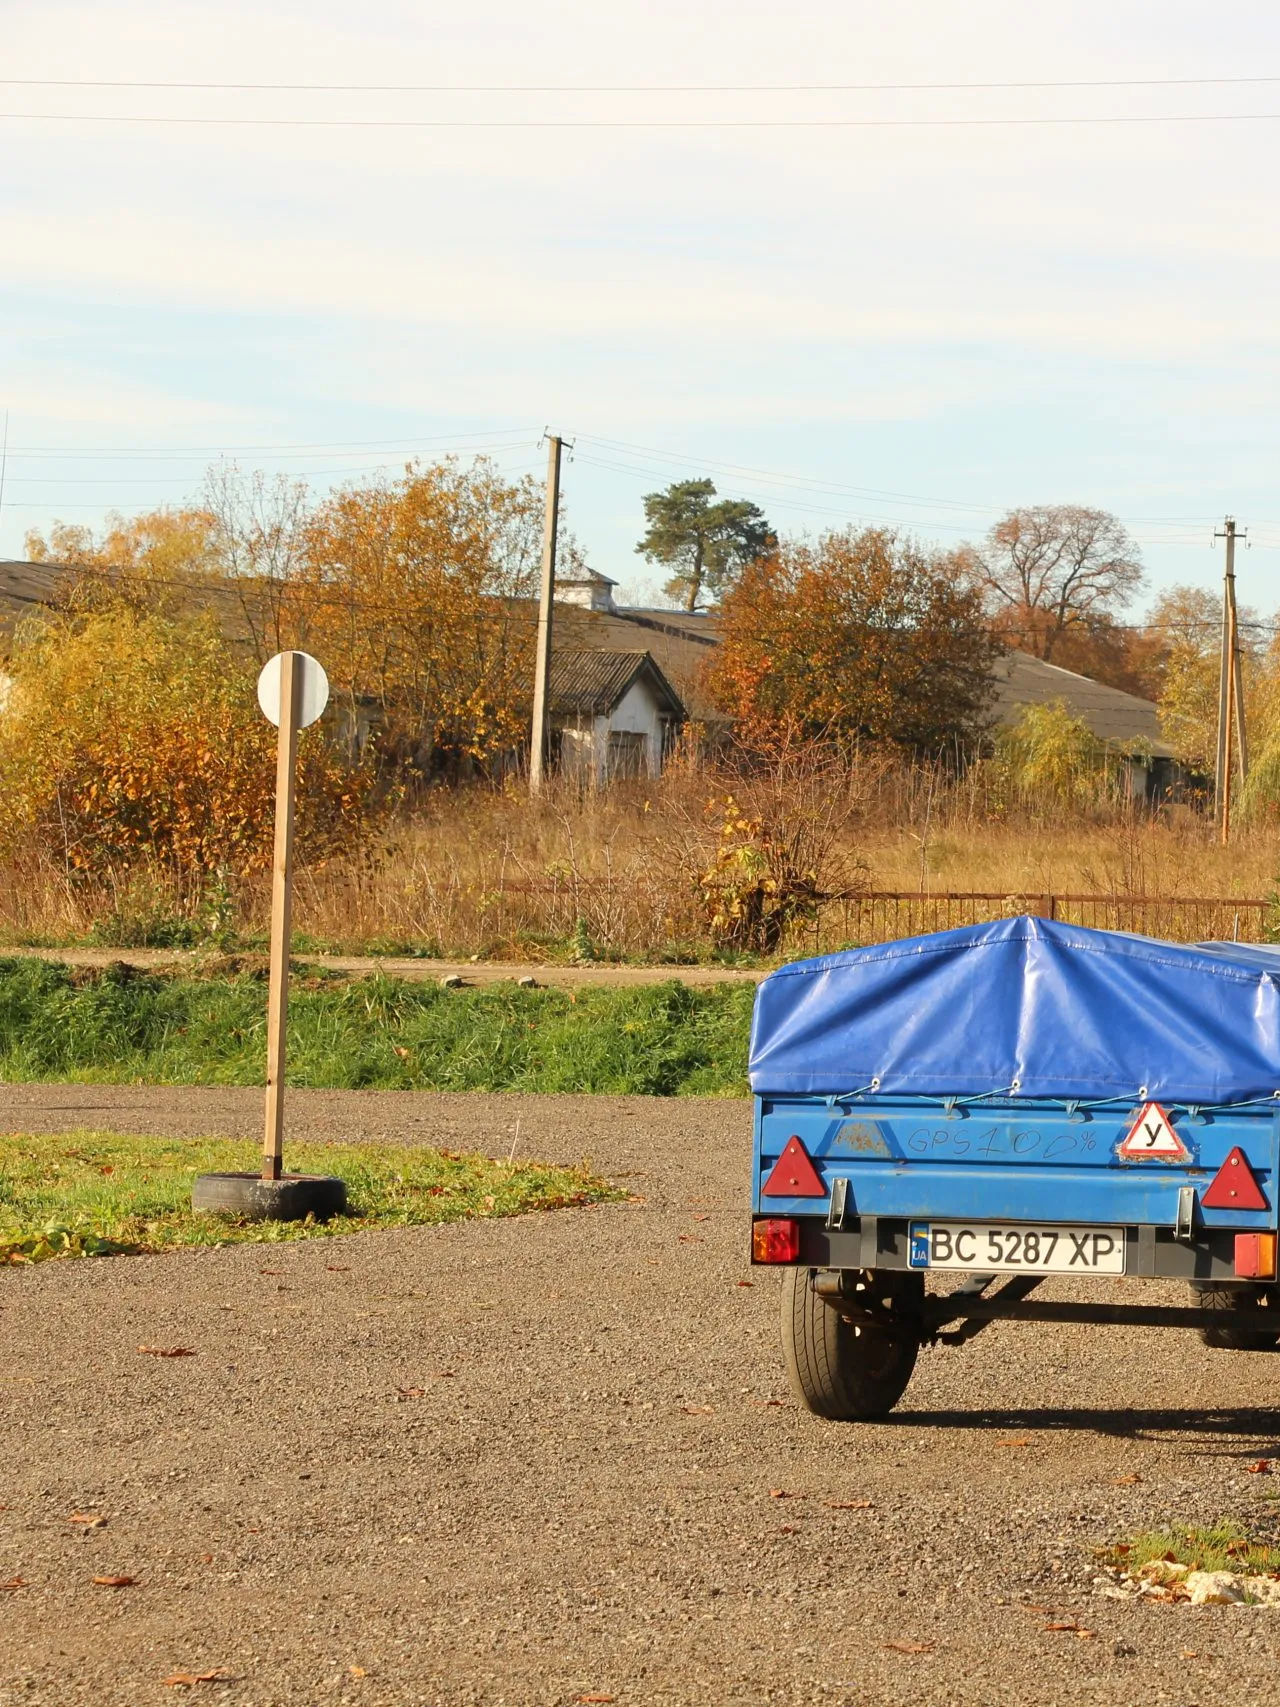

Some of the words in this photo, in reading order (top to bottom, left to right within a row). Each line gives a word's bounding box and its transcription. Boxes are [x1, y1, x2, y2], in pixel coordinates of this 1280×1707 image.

[908, 1128, 971, 1154] GPS
[912, 1250, 927, 1261] UA
[931, 1229, 976, 1262] BC
[987, 1230, 1059, 1264] 5287
[1068, 1232, 1114, 1266] XP
